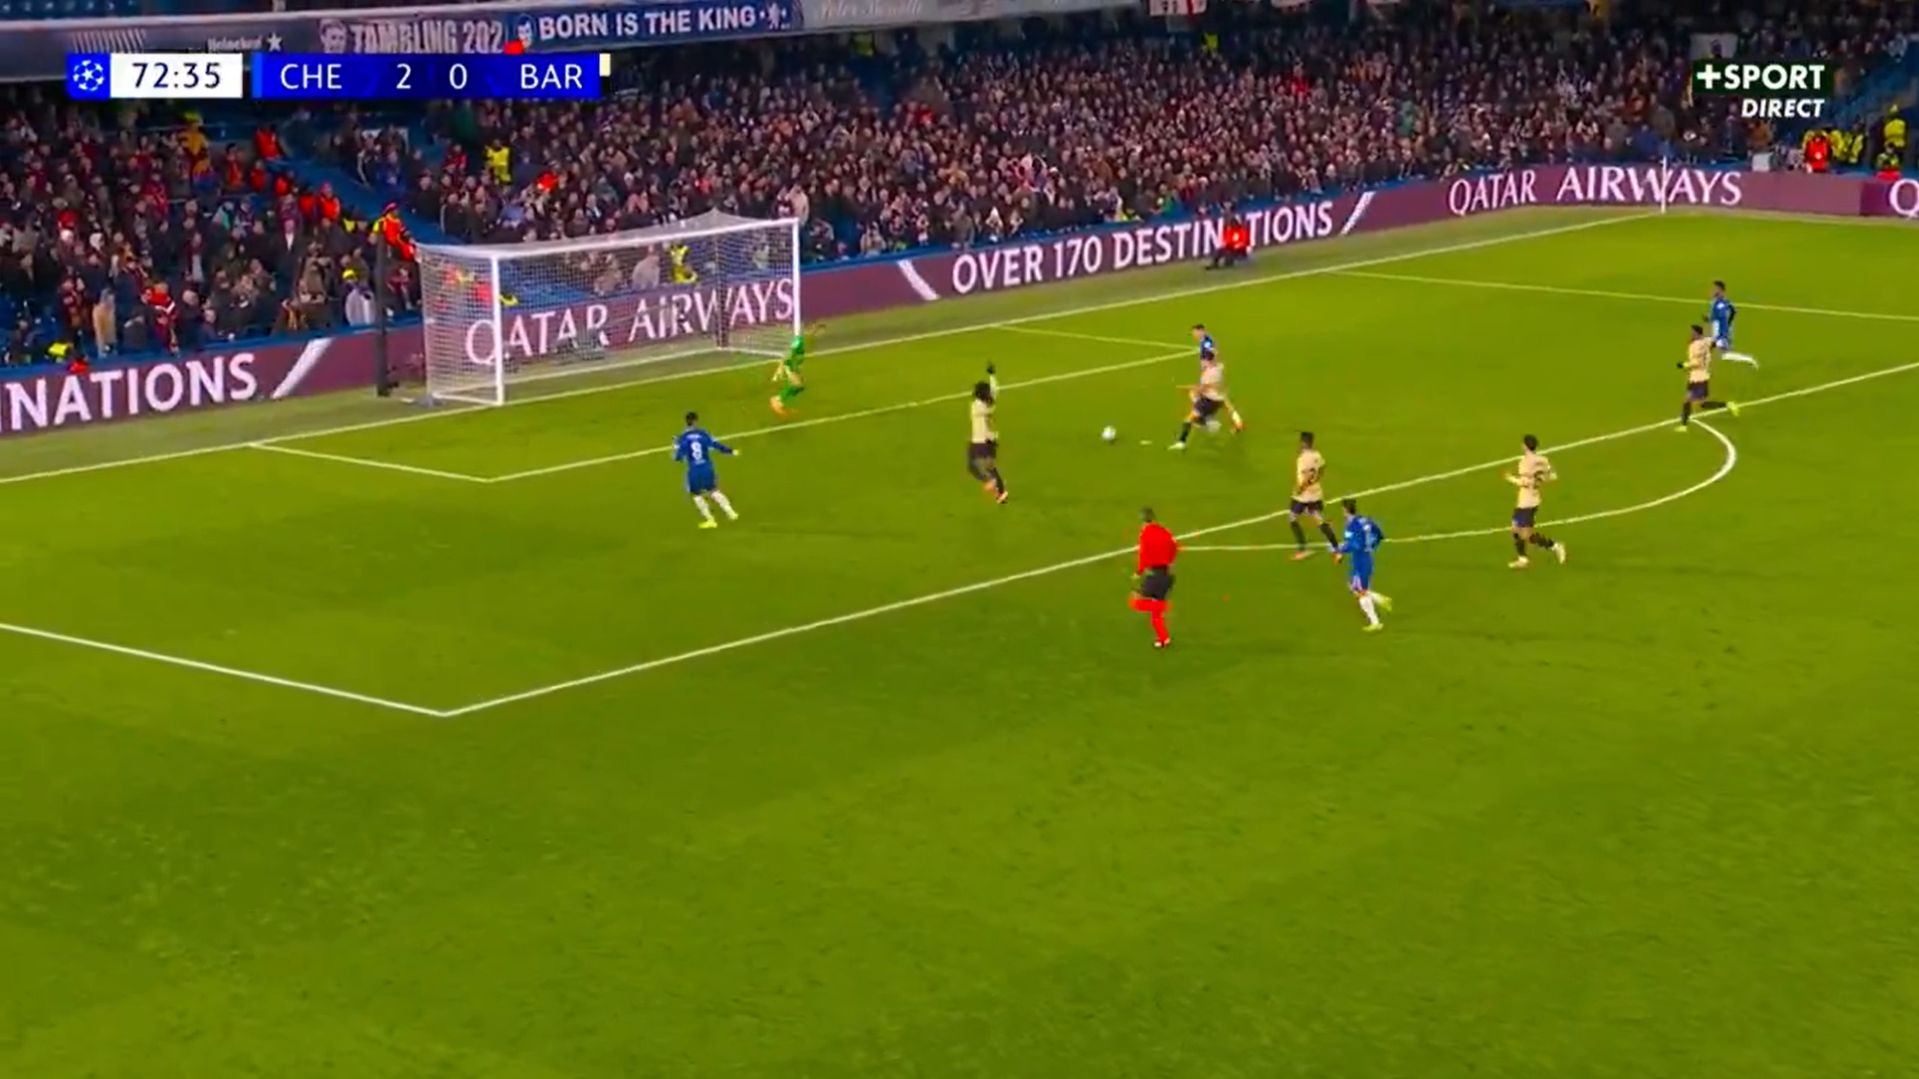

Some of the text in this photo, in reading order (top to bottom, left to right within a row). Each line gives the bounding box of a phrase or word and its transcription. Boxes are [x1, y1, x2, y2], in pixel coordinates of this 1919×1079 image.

[349, 19, 457, 53] TAMBLING
[539, 6, 756, 40] BORN IS THE KING
[1449, 166, 1742, 216] QATAR AIRWAYS
[952, 201, 1333, 294] OVER 170 DESTINTIONS
[466, 279, 795, 365] QATAR AIRWAYS
[0, 352, 257, 434] NATIONS
[690, 441, 703, 460] 8
